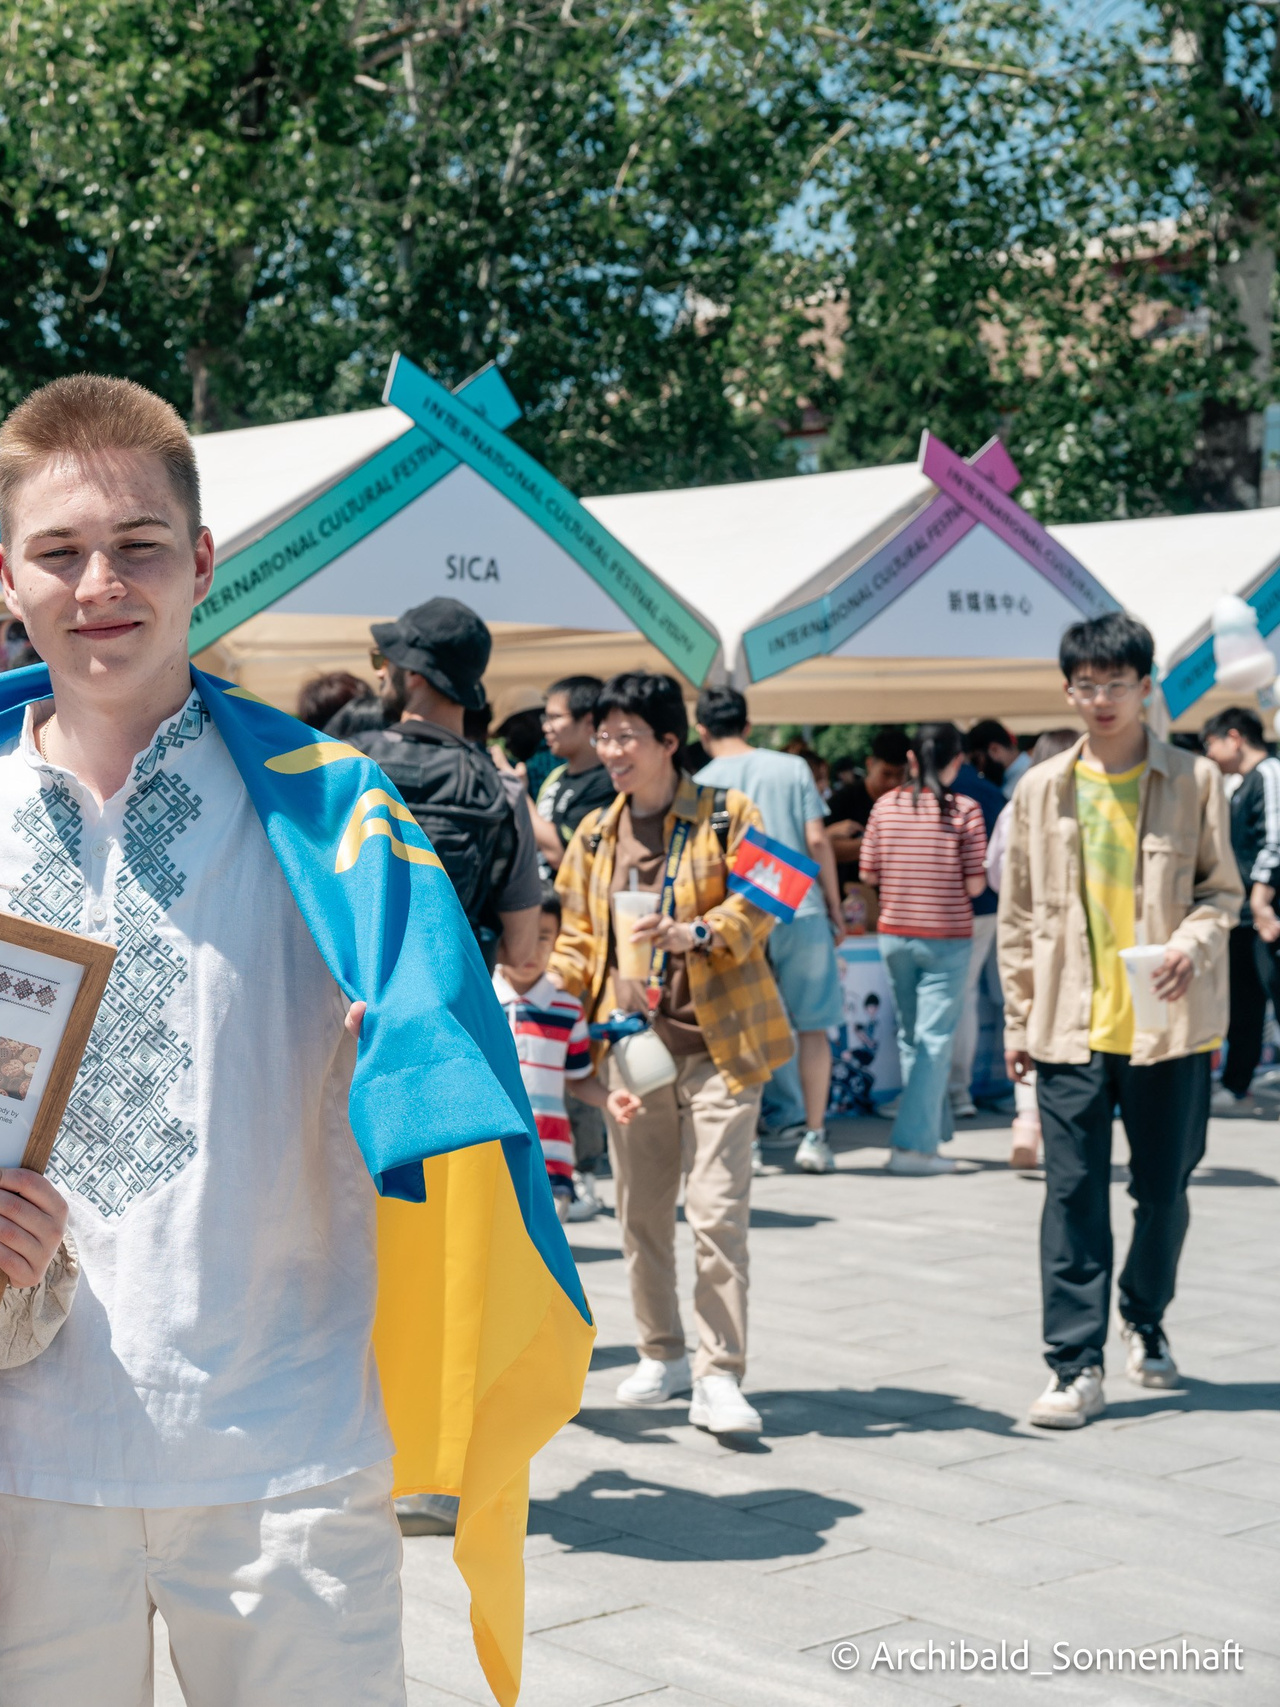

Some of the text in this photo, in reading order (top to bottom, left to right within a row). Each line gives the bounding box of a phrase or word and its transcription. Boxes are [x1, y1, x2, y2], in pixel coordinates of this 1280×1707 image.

[422, 396, 543, 503] INTERNATIONAL
[545, 497, 608, 566] CULTURAL
[190, 528, 319, 630] NTERNATIONAL
[318, 474, 394, 539] CULTURAL
[446, 554, 499, 583] SICA
[948, 590, 1032, 616] 新媒体中心
[10, 1109, 20, 1119] by
